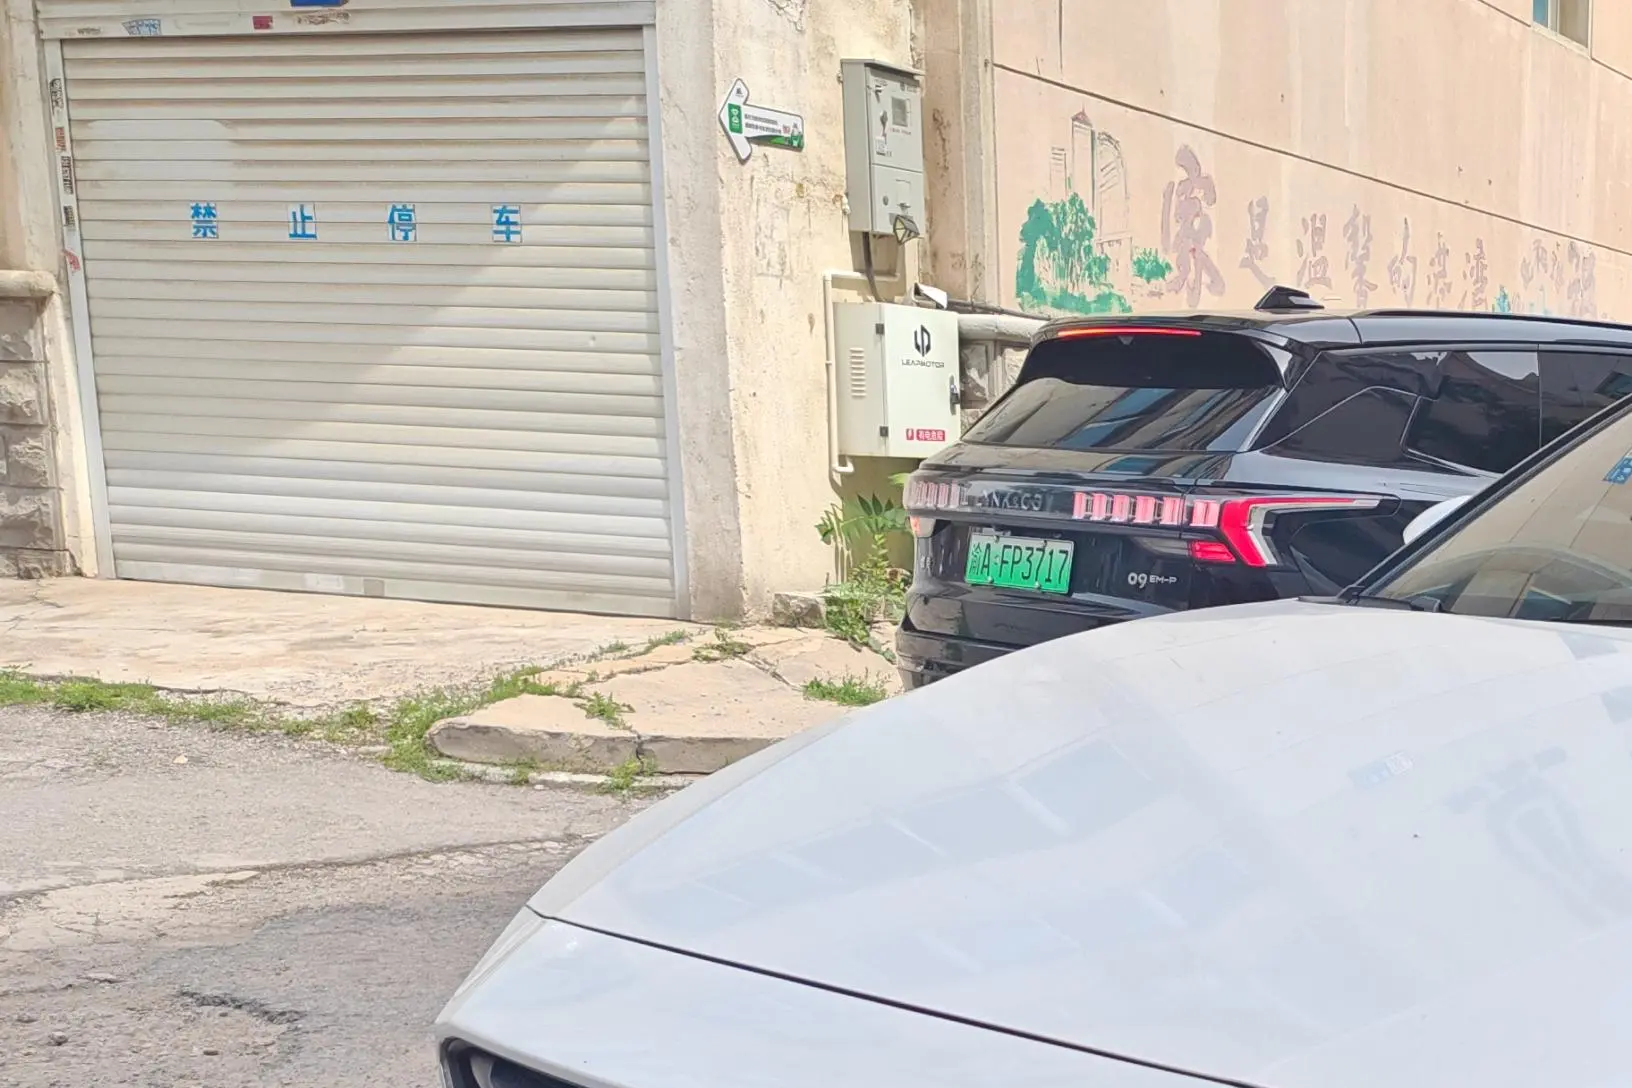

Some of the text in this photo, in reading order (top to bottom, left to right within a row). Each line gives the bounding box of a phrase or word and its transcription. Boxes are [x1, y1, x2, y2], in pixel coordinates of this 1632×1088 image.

[190, 202, 520, 243] 禁止停车
[1127, 572, 1177, 589] 09 EM-P
